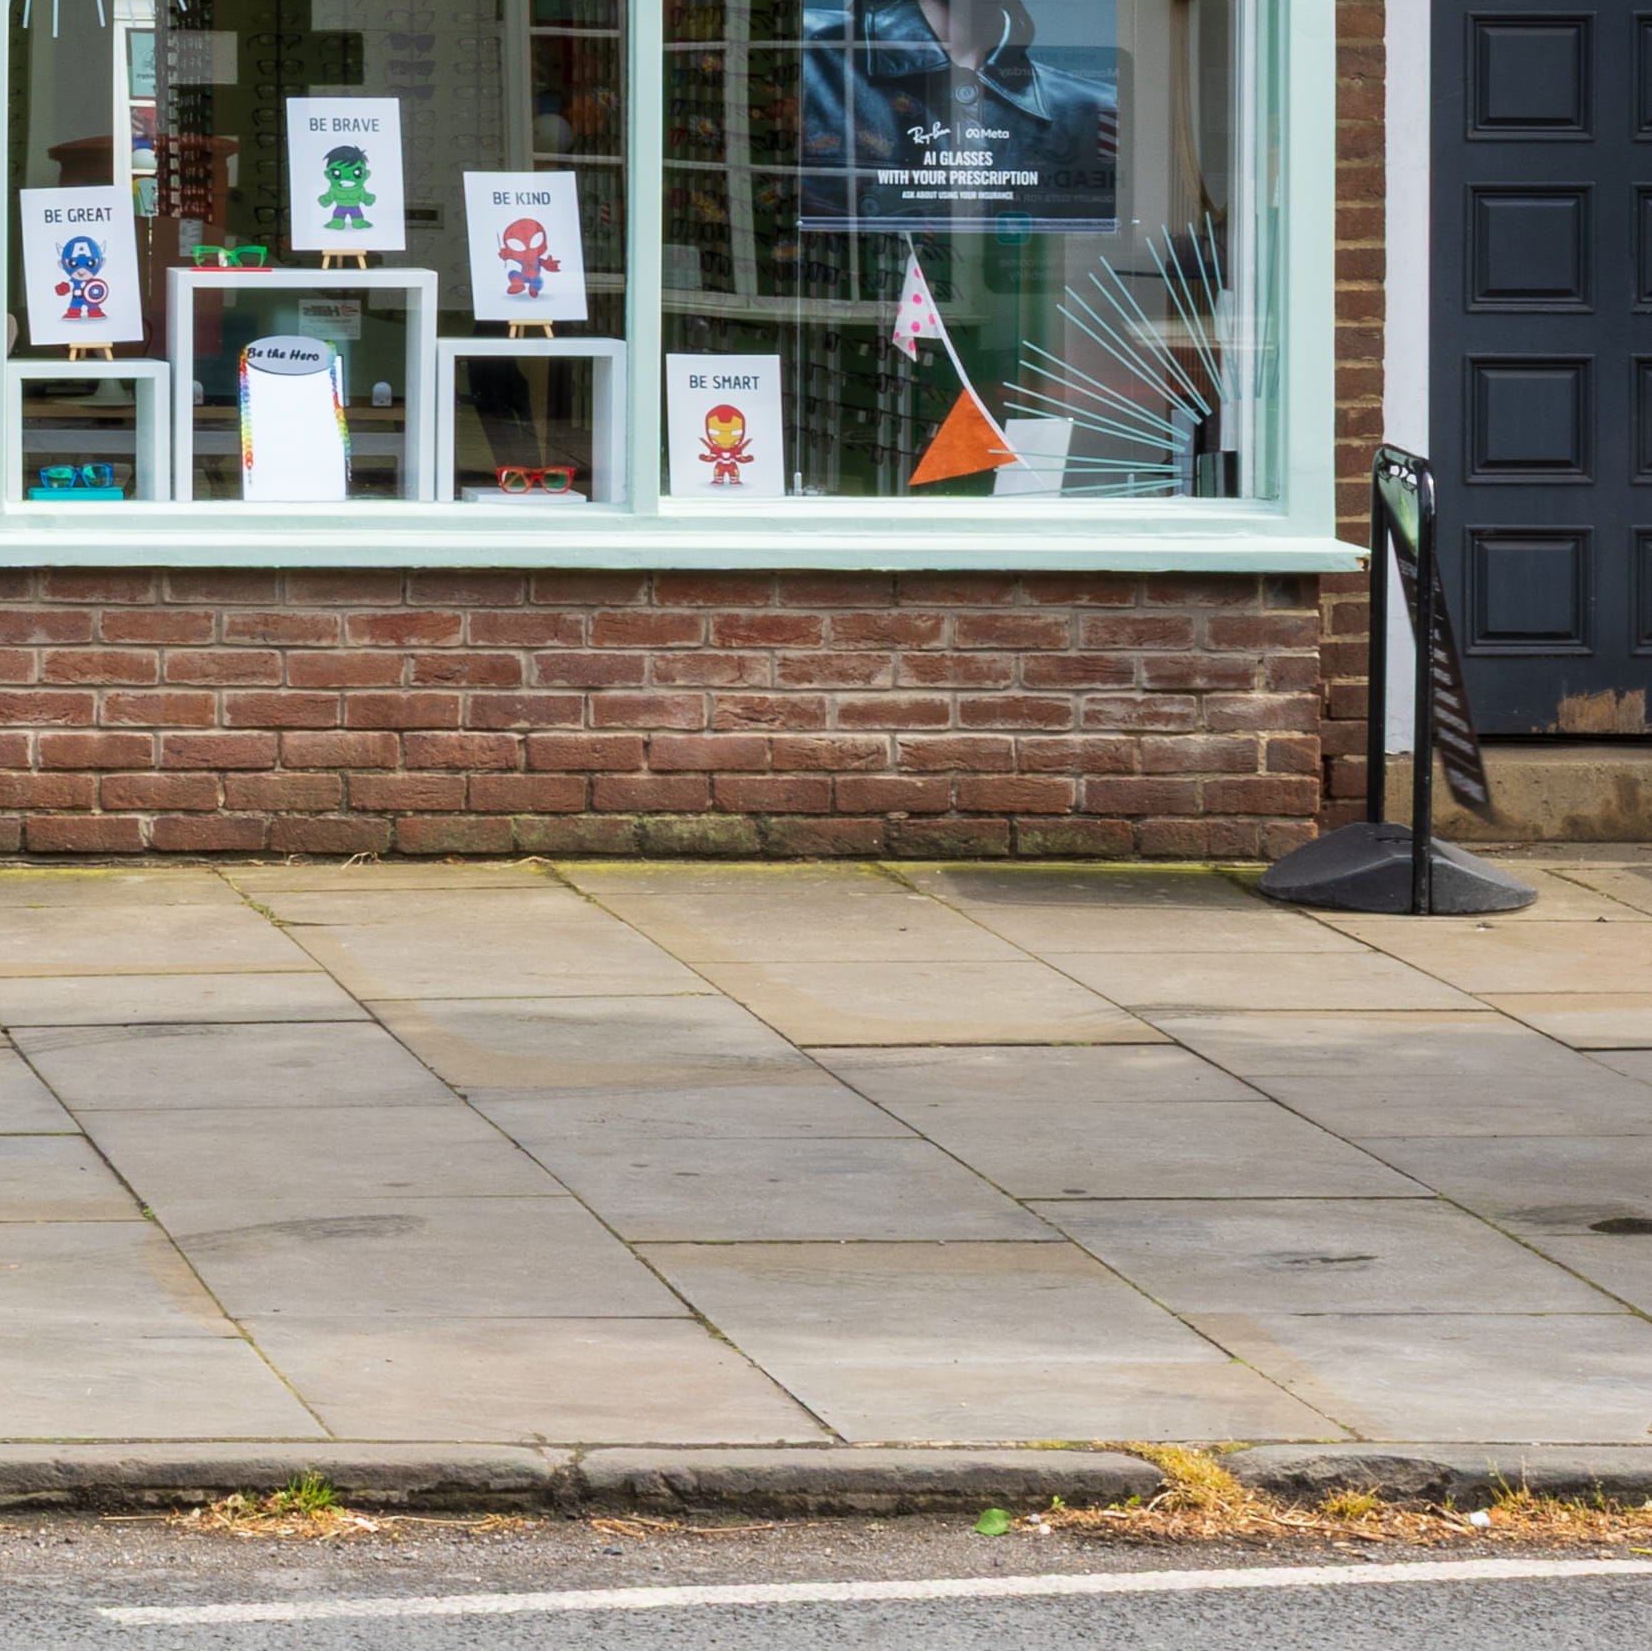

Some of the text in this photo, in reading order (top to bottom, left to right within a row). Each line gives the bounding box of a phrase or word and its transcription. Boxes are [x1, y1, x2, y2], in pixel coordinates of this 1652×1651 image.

[309, 117, 380, 132] BE BRAVE
[907, 121, 1010, 144] Ray-Ban Meta
[923, 150, 993, 166] AI GLASSES
[877, 169, 1038, 186] WITH YOUR PRESCRIPTION
[492, 191, 551, 205] BE KIND
[901, 191, 1014, 200] ASK ABOUT USING YOUR INSURANCE
[44, 207, 113, 224] BE GREAT
[247, 347, 320, 361] Be the Hero
[689, 374, 760, 390] BE SMART
